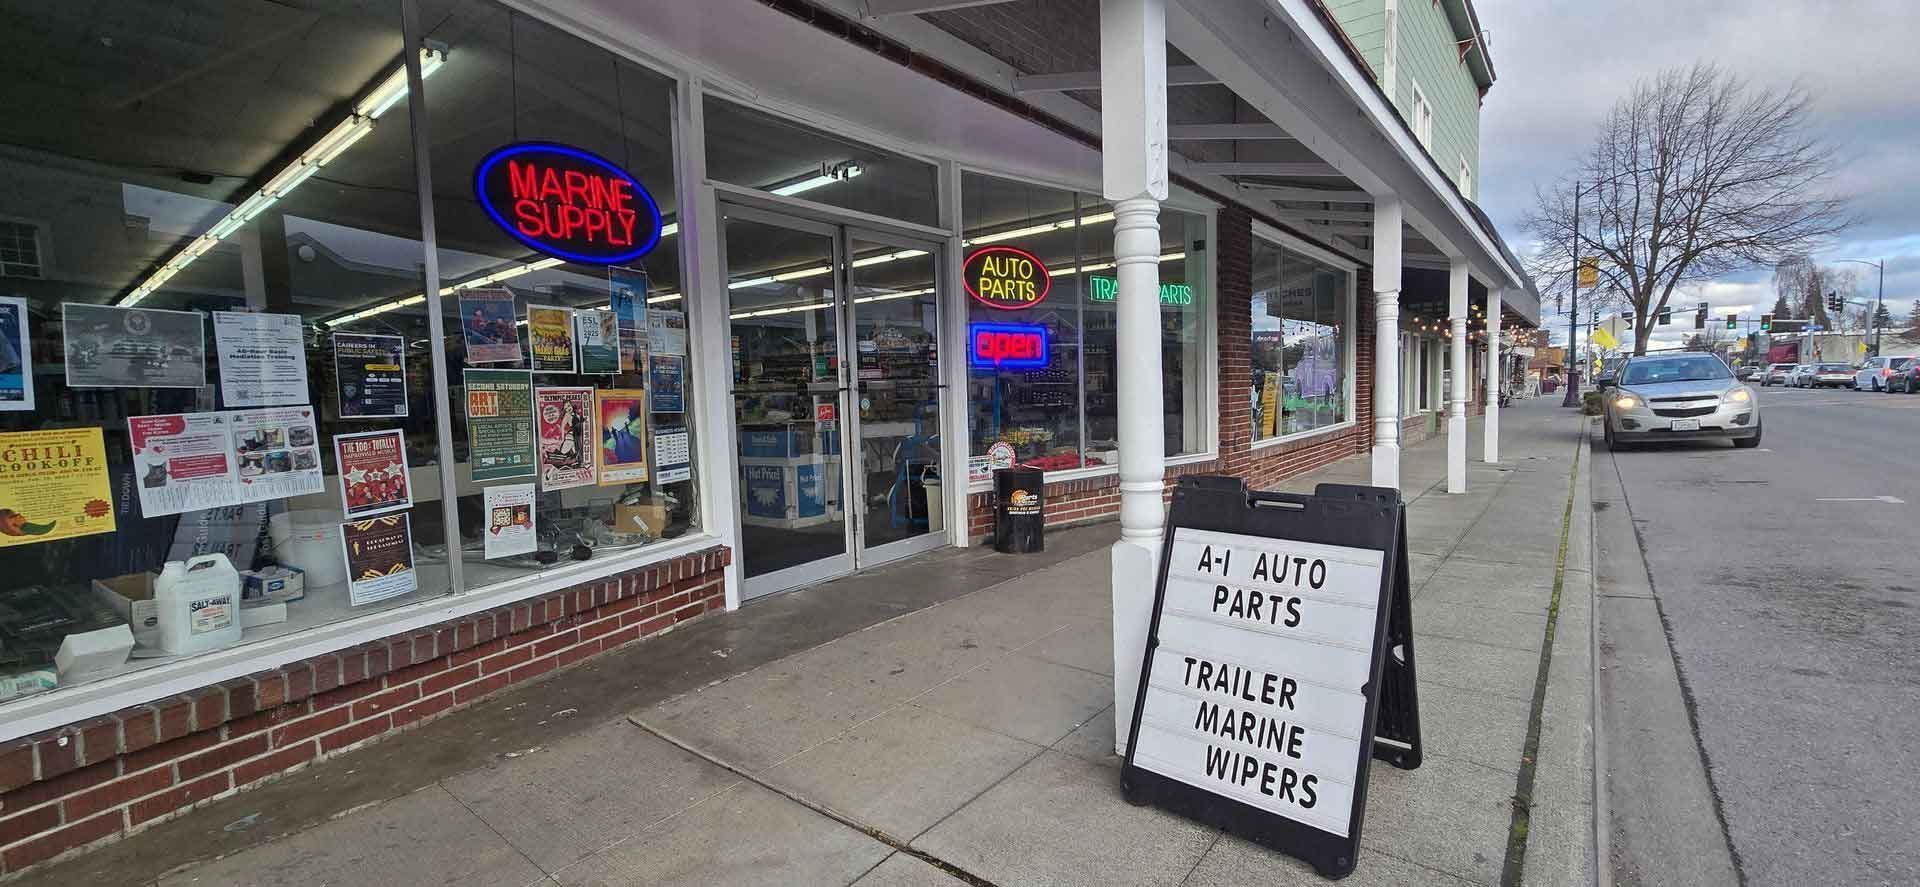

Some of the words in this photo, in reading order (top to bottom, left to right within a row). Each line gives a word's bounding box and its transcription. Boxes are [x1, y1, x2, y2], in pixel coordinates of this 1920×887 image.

[509, 159, 635, 214] MARINE
[514, 199, 636, 246] SUPPLY
[981, 255, 1033, 280] AUTO
[979, 277, 1036, 301] PARTS
[1159, 283, 1192, 305] ARTS
[976, 332, 1042, 366] open
[470, 392, 496, 406] ART
[470, 406, 497, 416] WALK
[2, 445, 82, 462] CHILI
[343, 442, 355, 454] THE
[372, 437, 396, 451] TOTALLY
[0, 457, 94, 473] COOK-OFF
[1252, 552, 1328, 590] AUTO
[191, 592, 231, 612] SALT-AWAY
[1212, 585, 1302, 629] PARTS
[1182, 656, 1298, 711] TRAILER
[1194, 701, 1305, 759] MARINE
[1206, 744, 1320, 809] WIPERS
